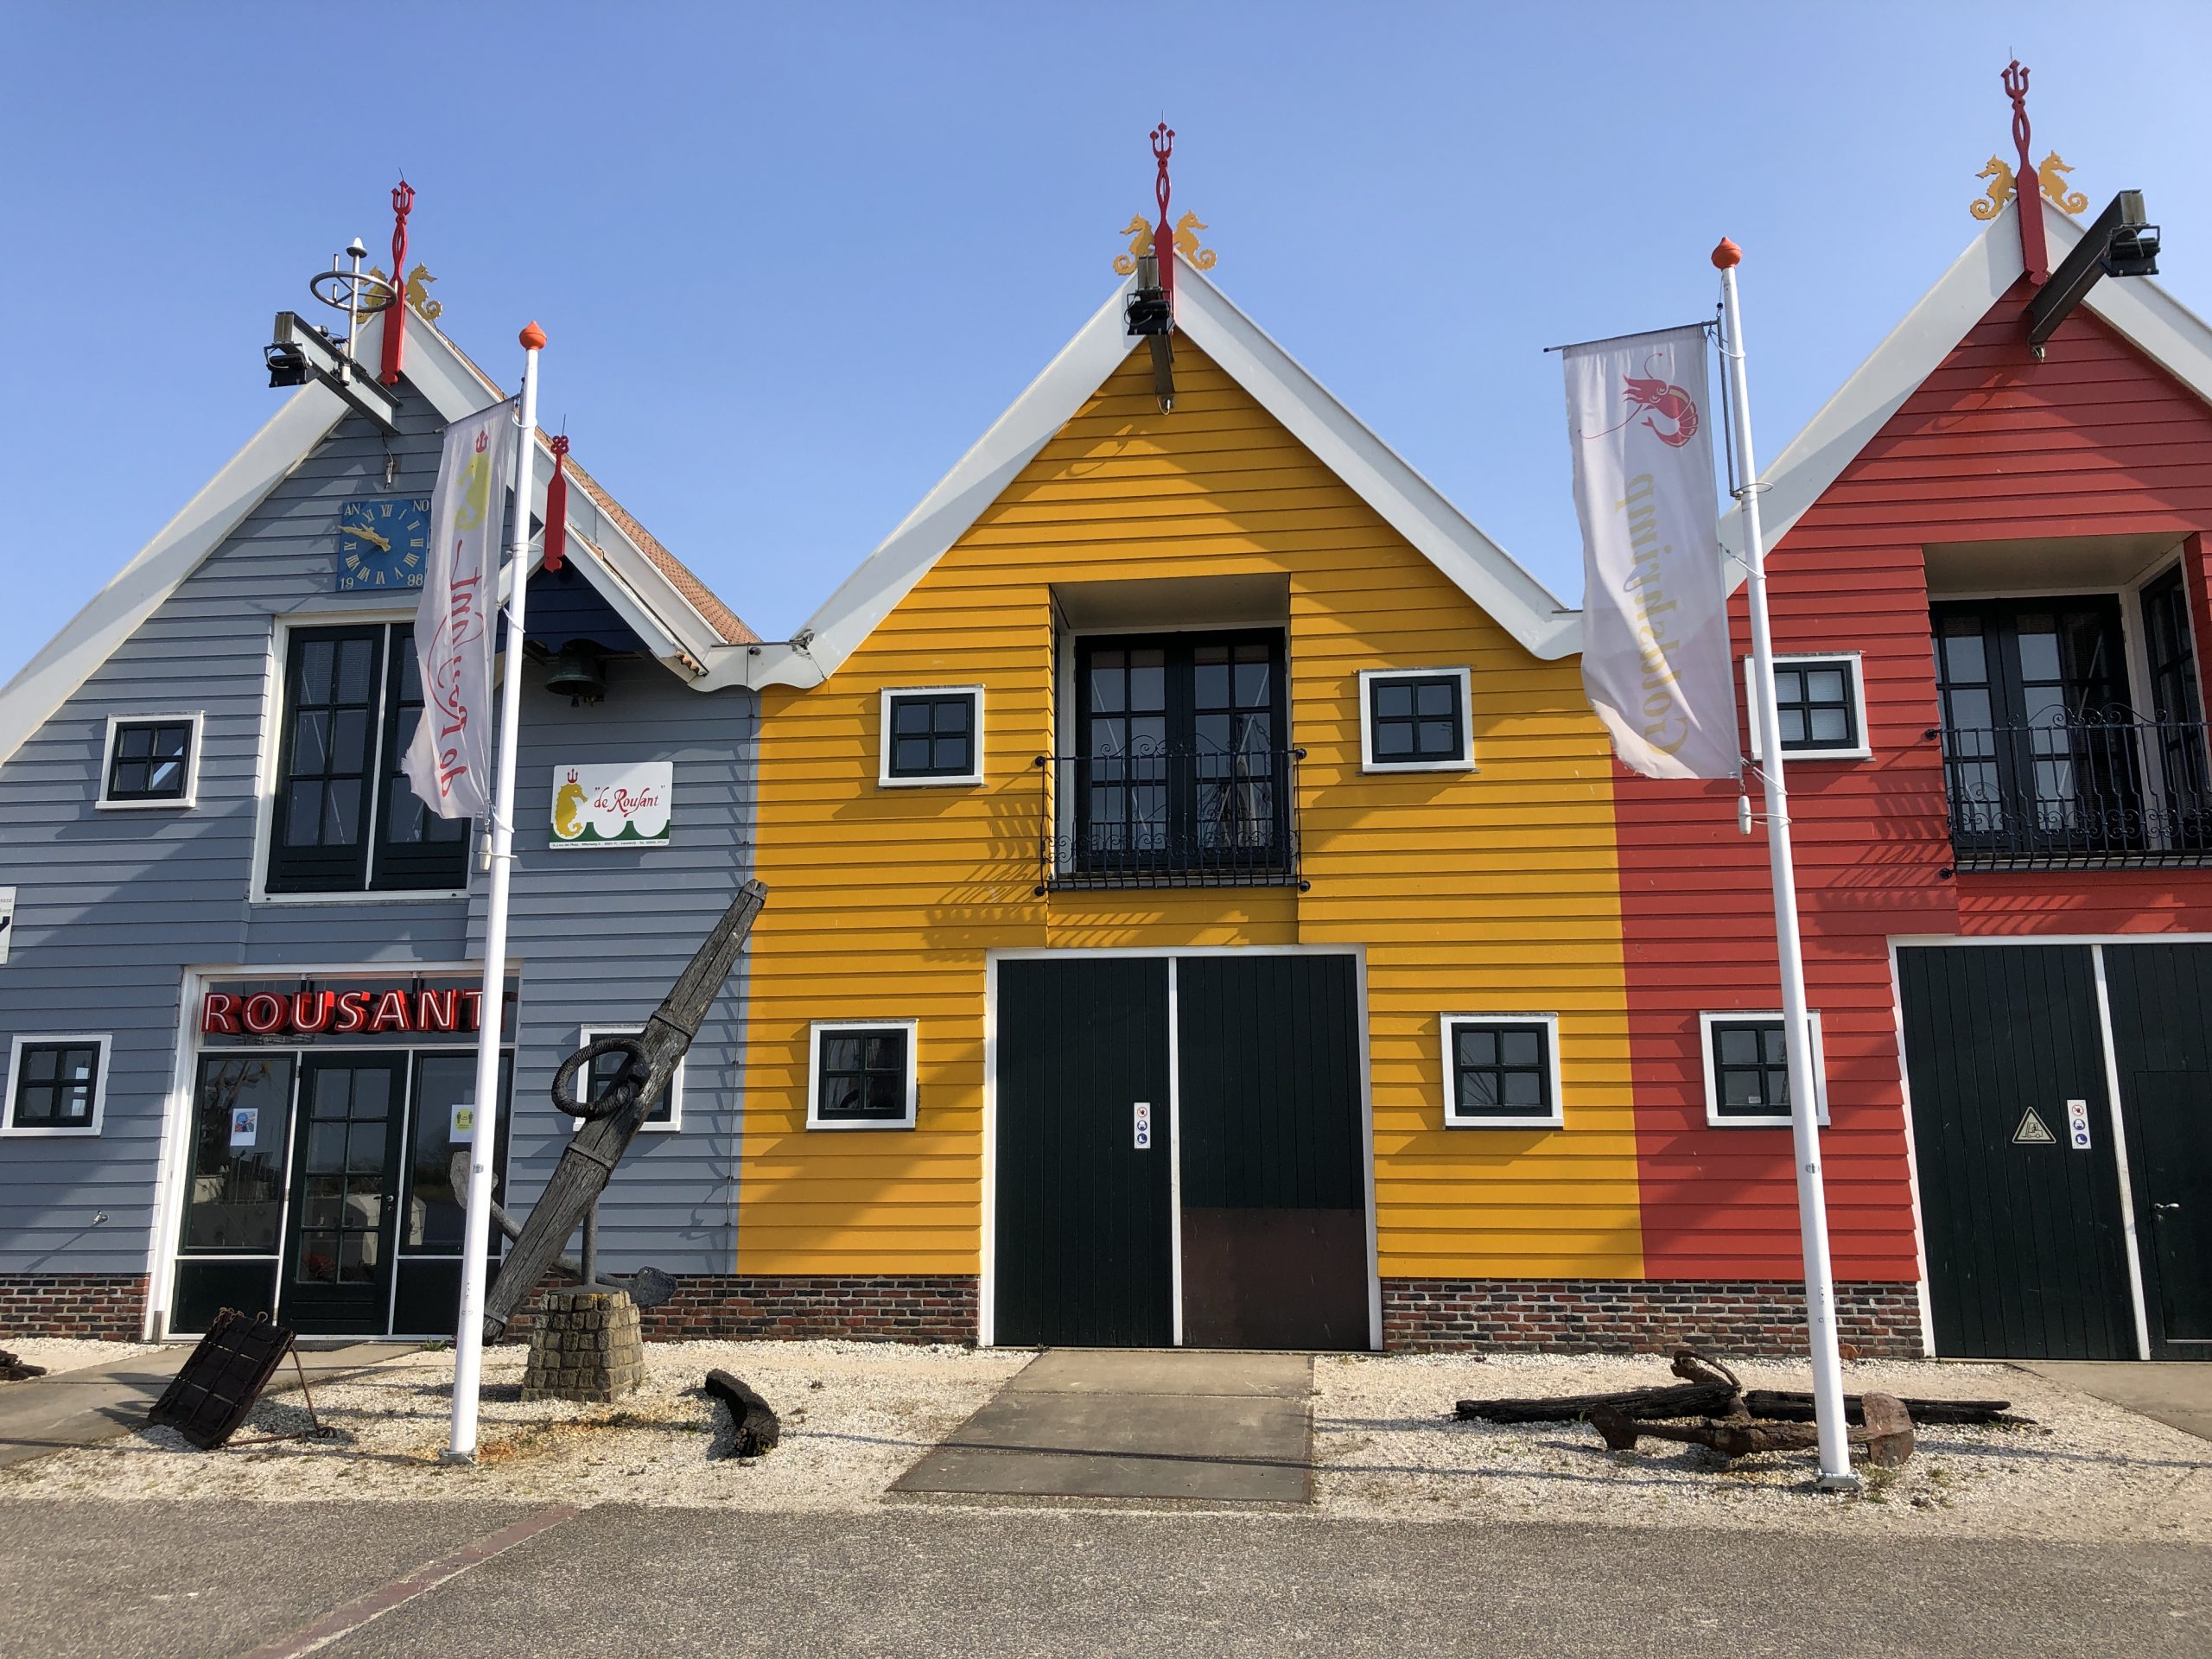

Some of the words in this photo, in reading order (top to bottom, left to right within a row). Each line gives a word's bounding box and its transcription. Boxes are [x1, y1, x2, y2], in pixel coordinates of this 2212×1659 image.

[344, 503, 360, 516] AN
[413, 499, 429, 512] NO
[340, 576, 354, 590] 19
[407, 573, 423, 587] 98
[201, 988, 484, 1033] ROUSANT
